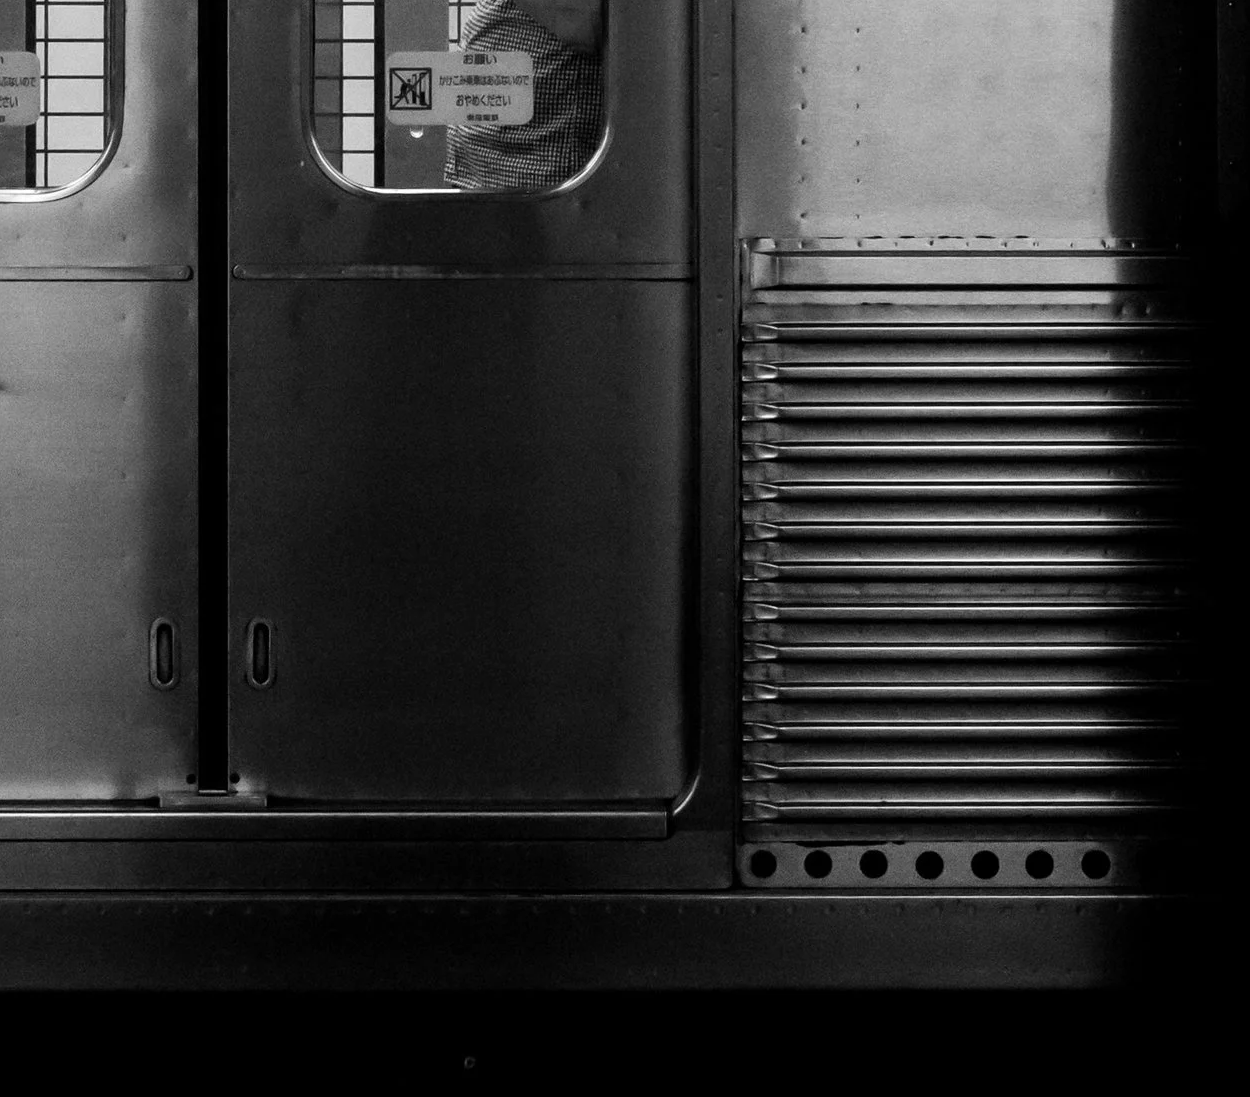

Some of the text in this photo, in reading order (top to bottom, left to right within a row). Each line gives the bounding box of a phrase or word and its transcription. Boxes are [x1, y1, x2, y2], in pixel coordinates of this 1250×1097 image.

[455, 94, 512, 107] おやめください
